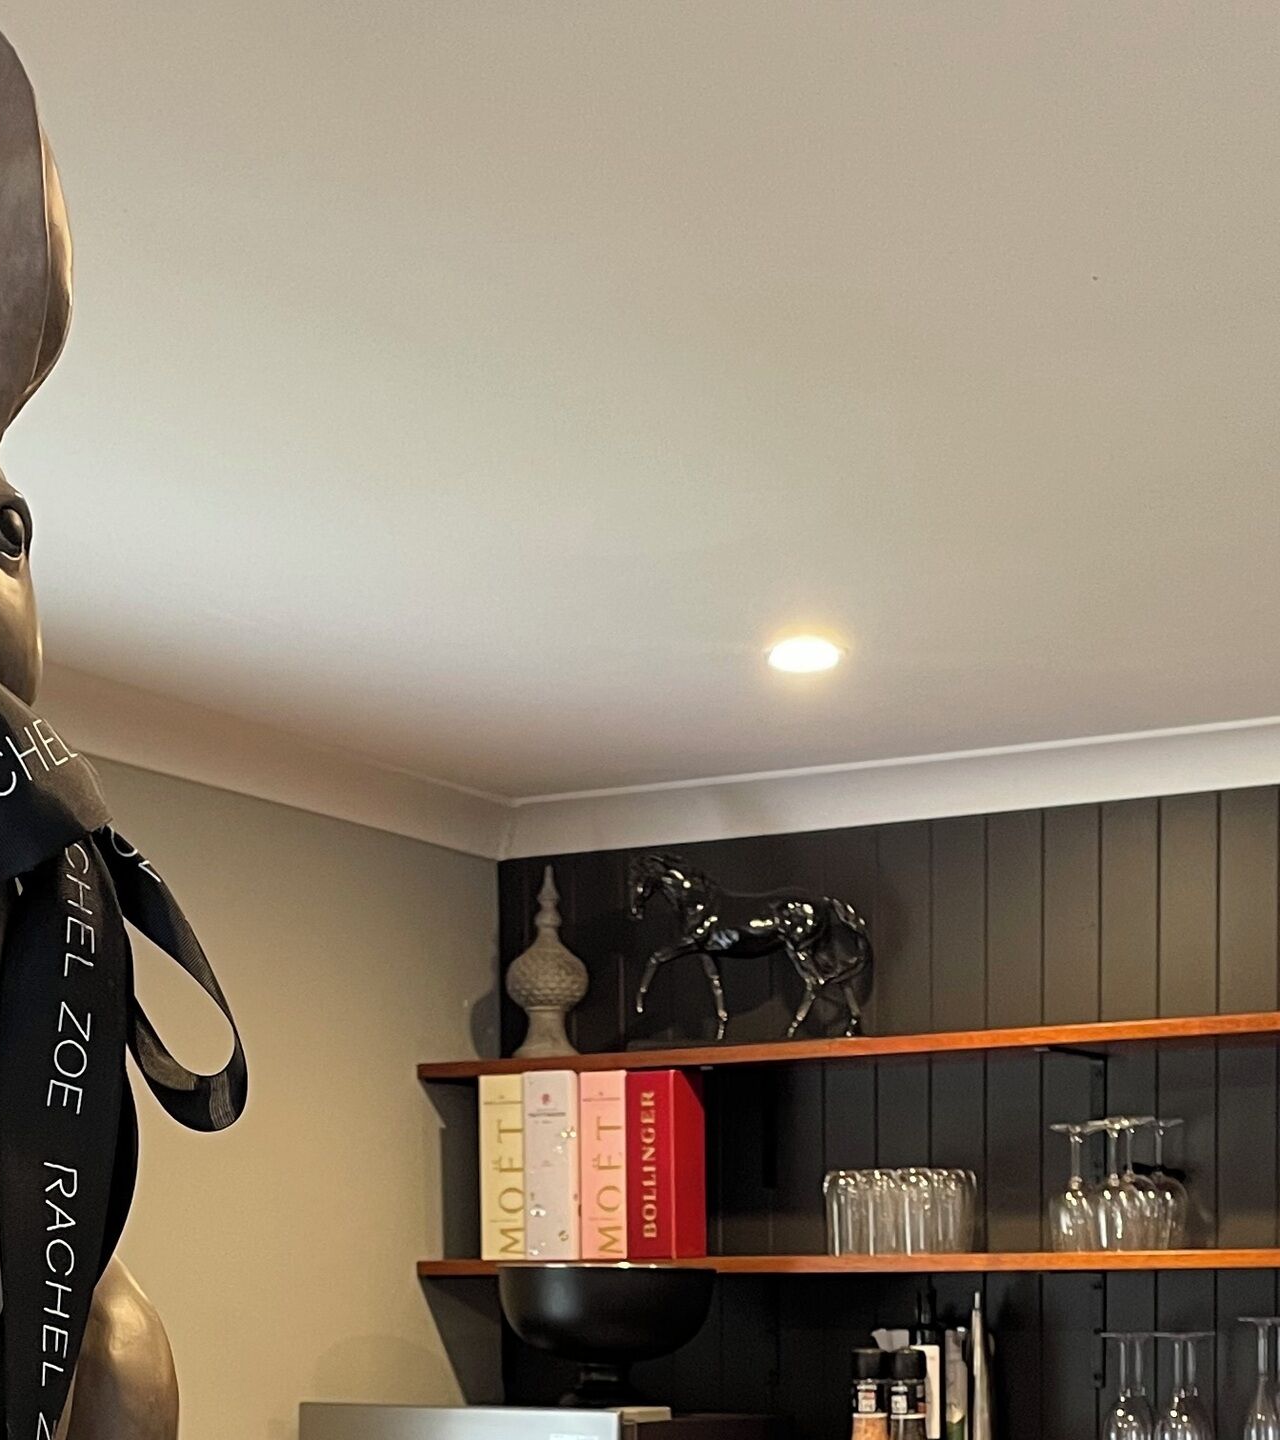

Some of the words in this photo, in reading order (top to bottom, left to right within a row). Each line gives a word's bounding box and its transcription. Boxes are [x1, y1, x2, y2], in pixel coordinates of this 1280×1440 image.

[46, 1000, 92, 1116] ZOE
[640, 1091, 657, 1238] BOLLINGER
[41, 1160, 79, 1388] RACHEL
